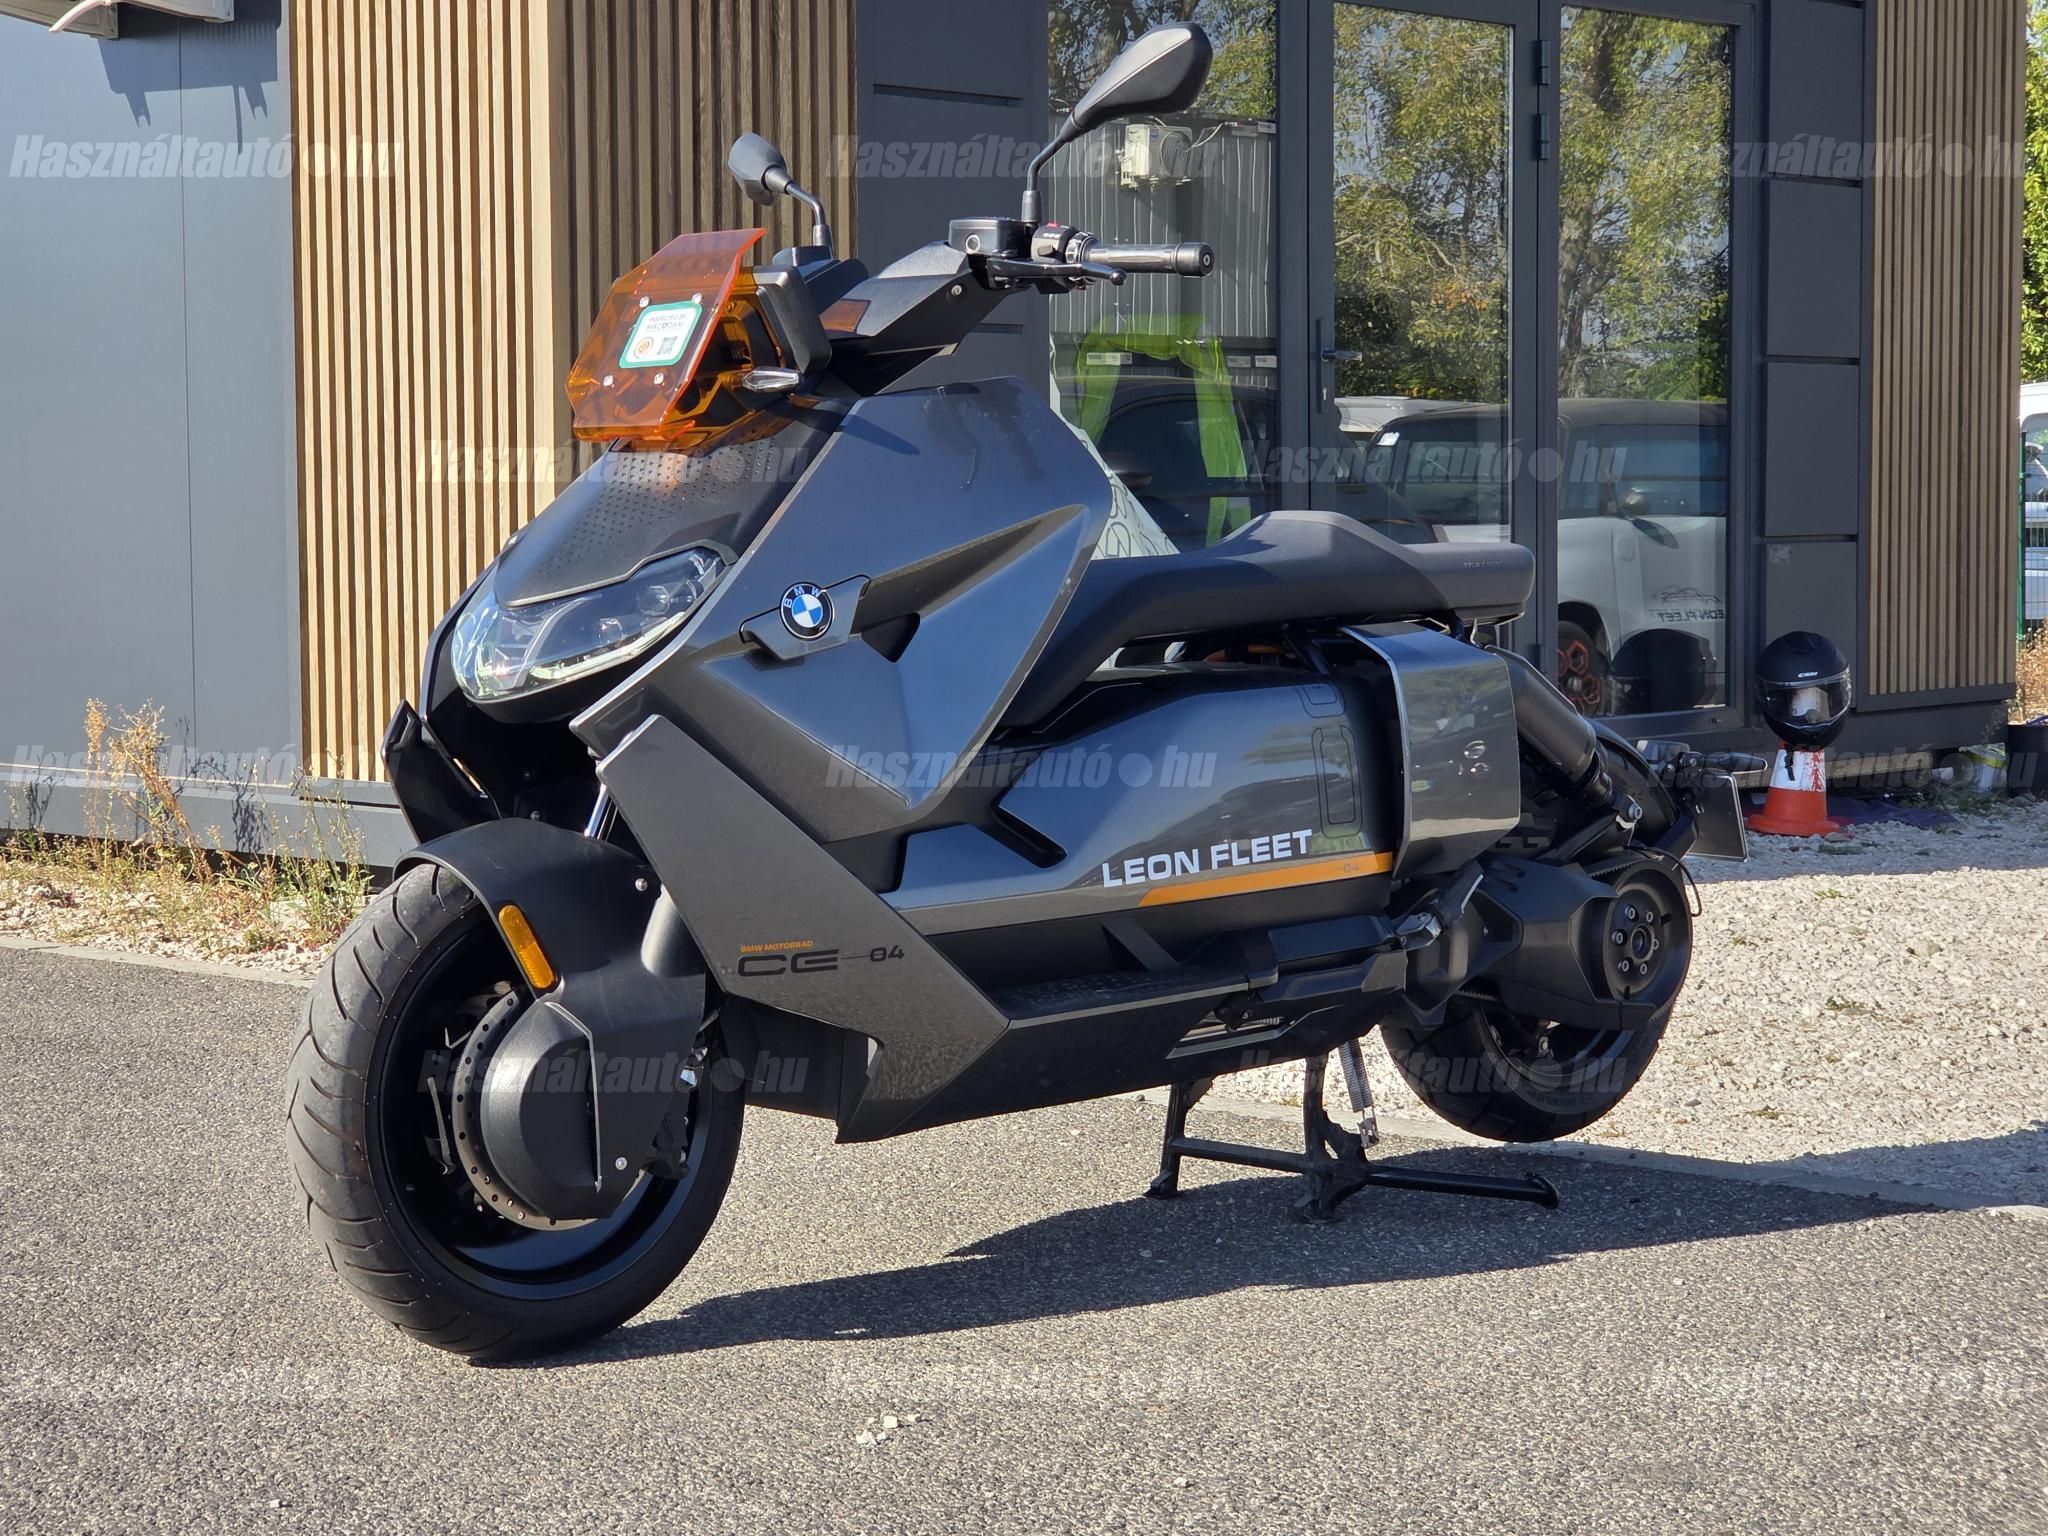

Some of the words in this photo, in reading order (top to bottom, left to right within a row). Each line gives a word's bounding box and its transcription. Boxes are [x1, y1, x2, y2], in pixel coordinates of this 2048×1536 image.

[784, 585, 822, 609] BMW
[1102, 849, 1199, 887] LEON
[1211, 829, 1312, 869] FLEET
[741, 944, 763, 953] BMW
[765, 940, 813, 951] MOTORRAD
